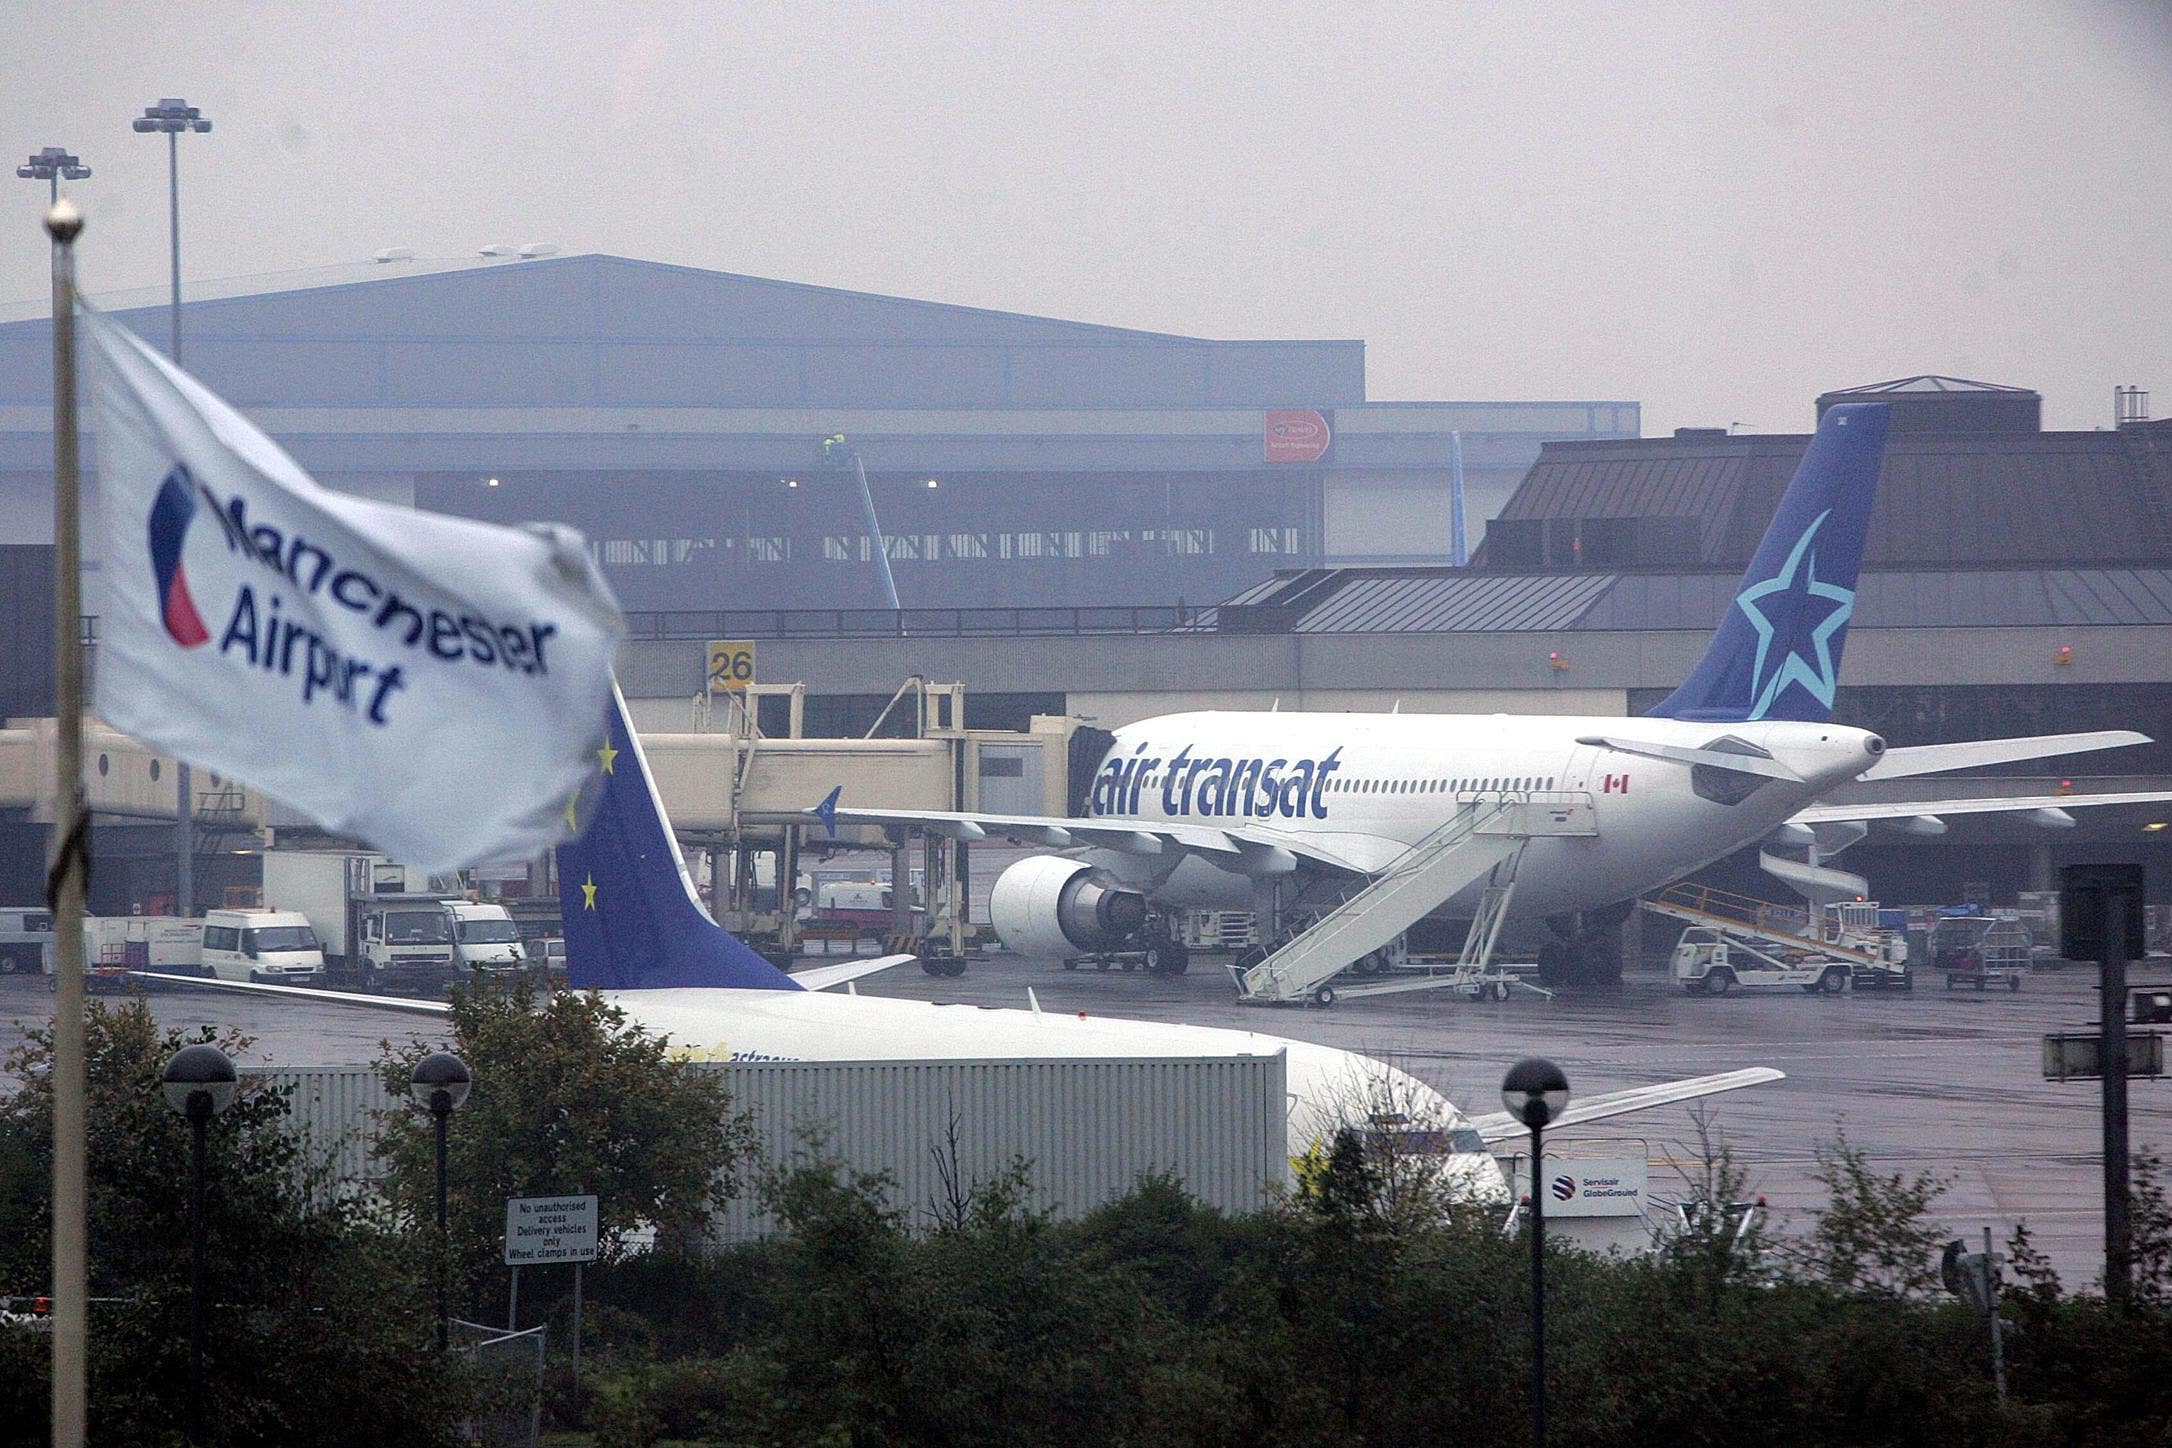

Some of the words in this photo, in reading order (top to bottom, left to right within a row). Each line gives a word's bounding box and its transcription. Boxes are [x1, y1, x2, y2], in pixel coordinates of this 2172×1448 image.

[227, 494, 558, 676] Mancheser
[709, 651, 752, 680] 26
[1092, 741, 1162, 816] air
[1163, 743, 1344, 819] transat
[1583, 1178, 1620, 1186] Servisair
[1583, 1189, 1638, 1198] GlobeGround
[519, 1203, 532, 1213] No
[534, 1201, 586, 1213] unauthorised
[538, 1215, 567, 1224] access
[517, 1225, 550, 1237] Delivery
[553, 1224, 587, 1235] vehicles
[543, 1236, 561, 1247] only
[509, 1249, 534, 1259] Wheel
[537, 1248, 567, 1259] clamps
[570, 1248, 578, 1256] in
[580, 1247, 595, 1256] use
